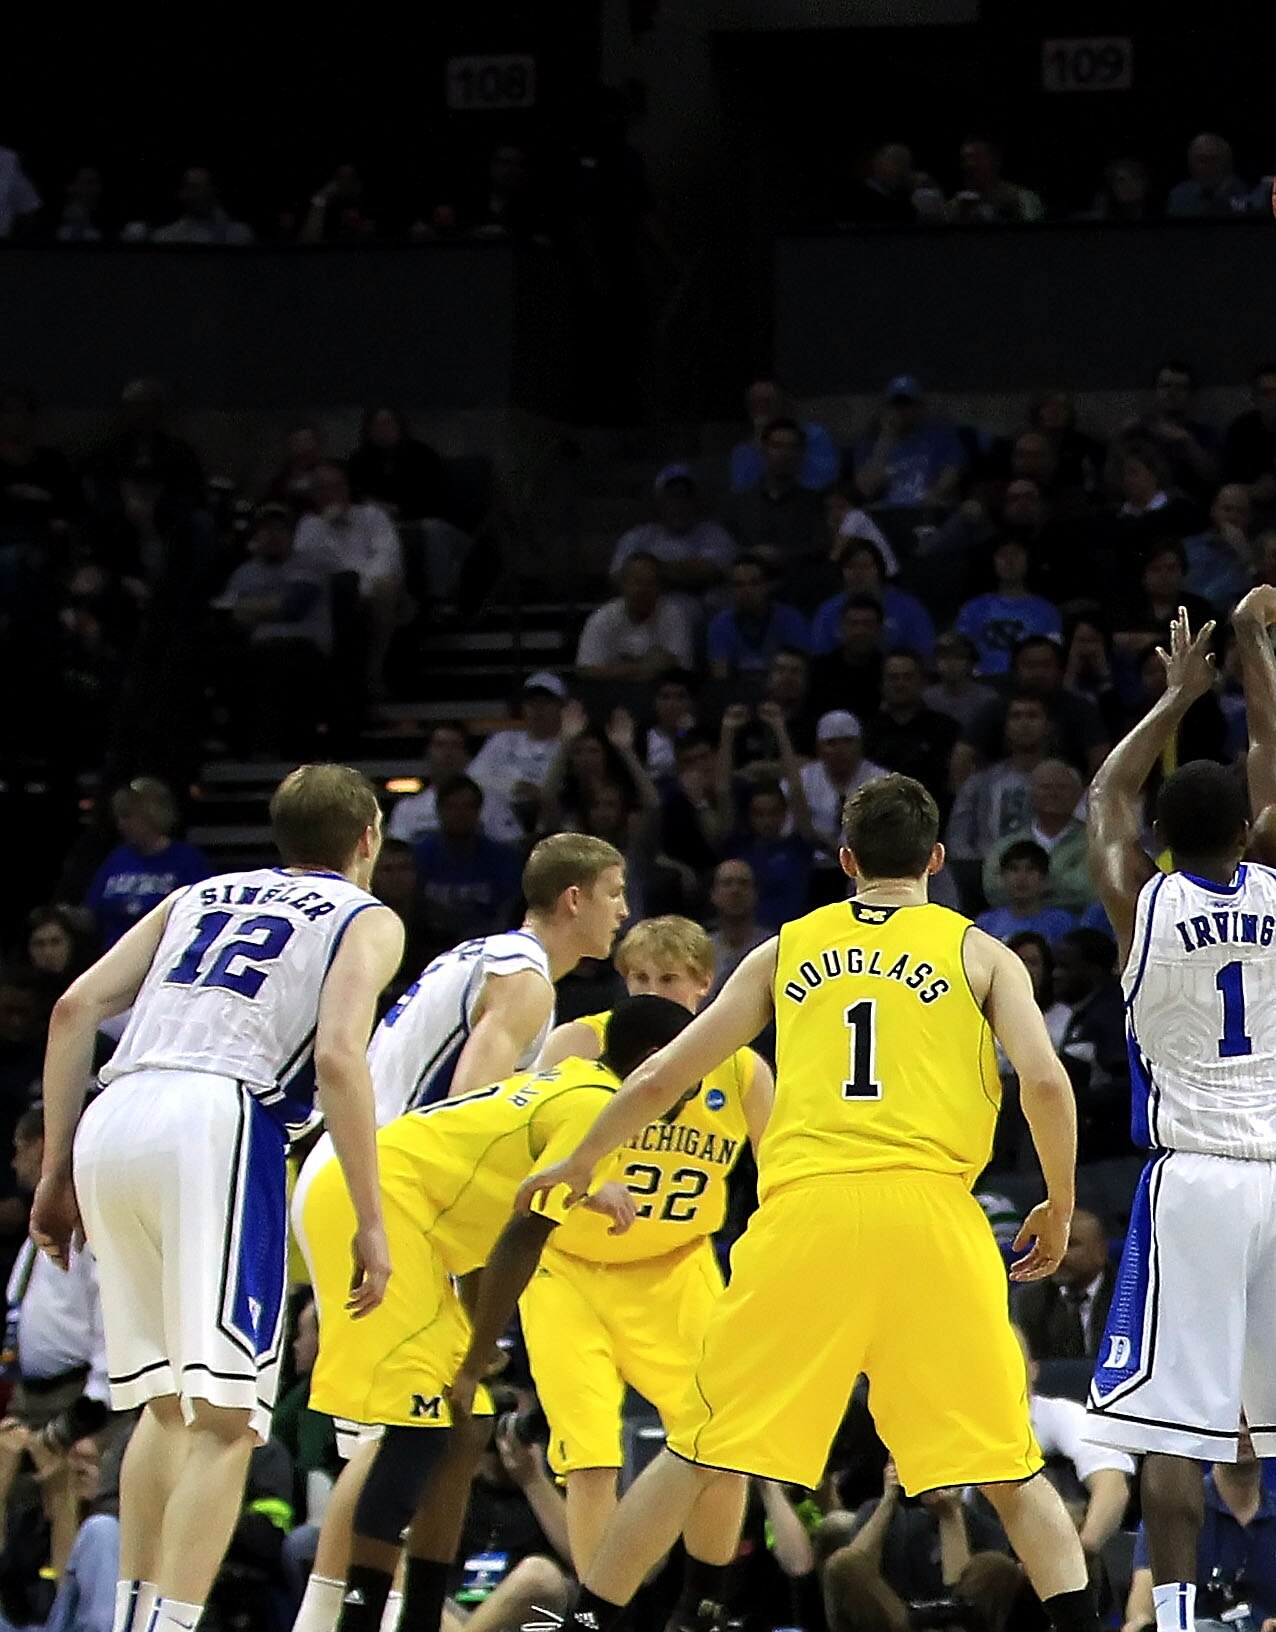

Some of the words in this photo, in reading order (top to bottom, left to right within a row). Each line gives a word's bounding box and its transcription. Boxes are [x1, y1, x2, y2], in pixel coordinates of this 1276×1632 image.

[457, 63, 528, 103] 108
[1052, 45, 1124, 82] 109
[163, 910, 295, 1000] 12
[1175, 911, 1276, 953] IRVING
[784, 948, 950, 1004] DOUGLASS
[1216, 960, 1253, 1058] 1
[844, 1000, 880, 1098] 1
[625, 1163, 709, 1221] 22
[410, 1394, 441, 1419] M
